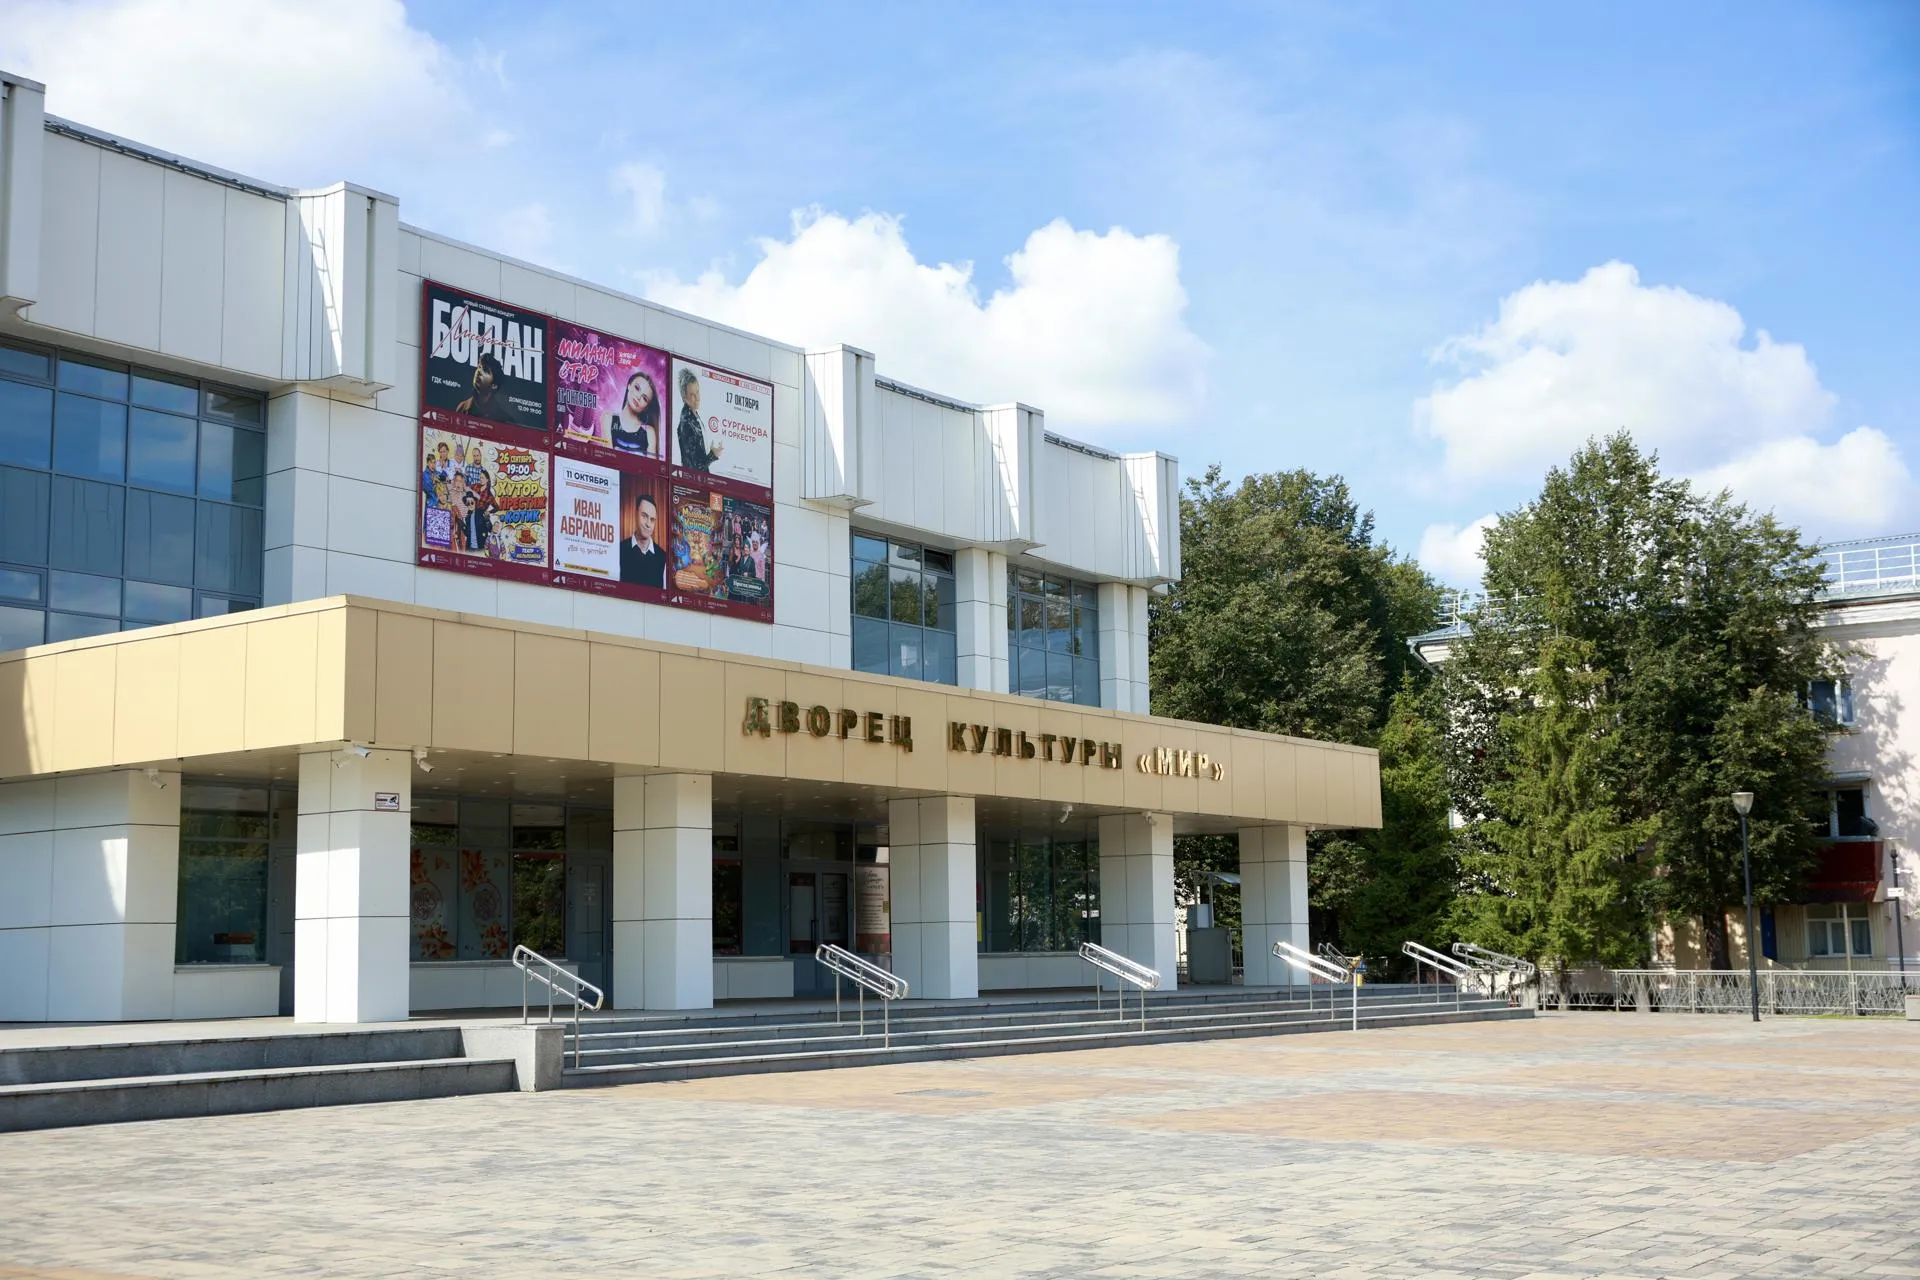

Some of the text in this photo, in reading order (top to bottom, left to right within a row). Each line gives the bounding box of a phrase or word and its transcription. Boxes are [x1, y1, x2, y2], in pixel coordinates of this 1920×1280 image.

[432, 298, 543, 384] БОГДАН
[557, 337, 615, 366] МИЛАНА
[558, 360, 599, 384] СТАР
[726, 391, 733, 404] 17
[734, 394, 760, 411] ОКТЯБРЯ
[722, 418, 769, 438] СУРГАНОВА
[722, 429, 757, 444] И ОРКЕСТР
[499, 451, 510, 463] 26
[506, 464, 530, 475] 19:00
[566, 470, 609, 487] 11 ОКТЯБРЯ
[498, 480, 538, 498] ХУТОР
[499, 495, 547, 511] ПРЕСТИЖ
[574, 498, 601, 520] ИВАН
[504, 510, 540, 524] КОТИК
[560, 515, 615, 544] АБРАМОВ
[743, 696, 1226, 783] ДВОРЕЦ КУЛЬТУРЫ «МИР»
